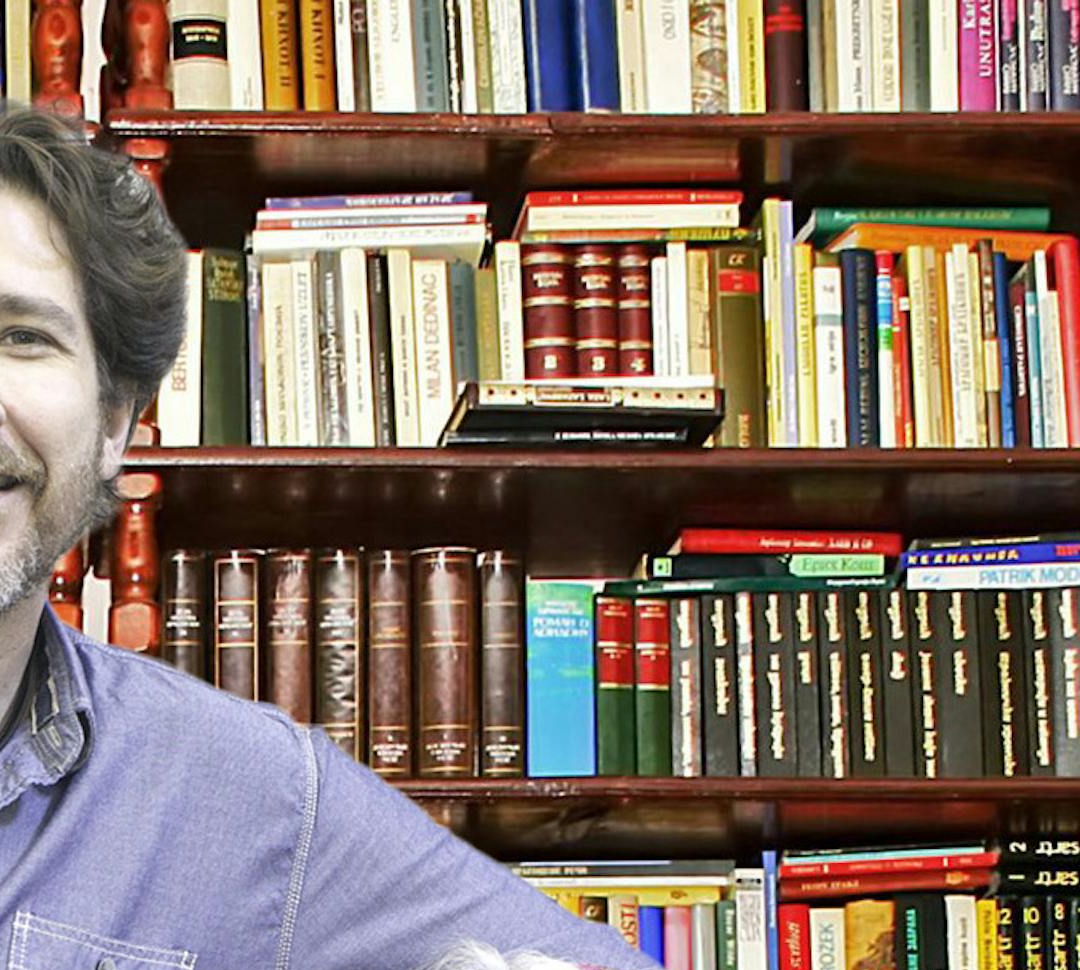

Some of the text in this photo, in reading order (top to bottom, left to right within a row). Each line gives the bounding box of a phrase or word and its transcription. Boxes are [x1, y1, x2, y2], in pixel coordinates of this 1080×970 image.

[419, 273, 441, 400] MILAN DEDINAC
[978, 569, 1037, 585] PATRIK
[1034, 870, 1080, 887] sartr
[1023, 906, 1041, 925] 10
[1053, 902, 1066, 921] 8
